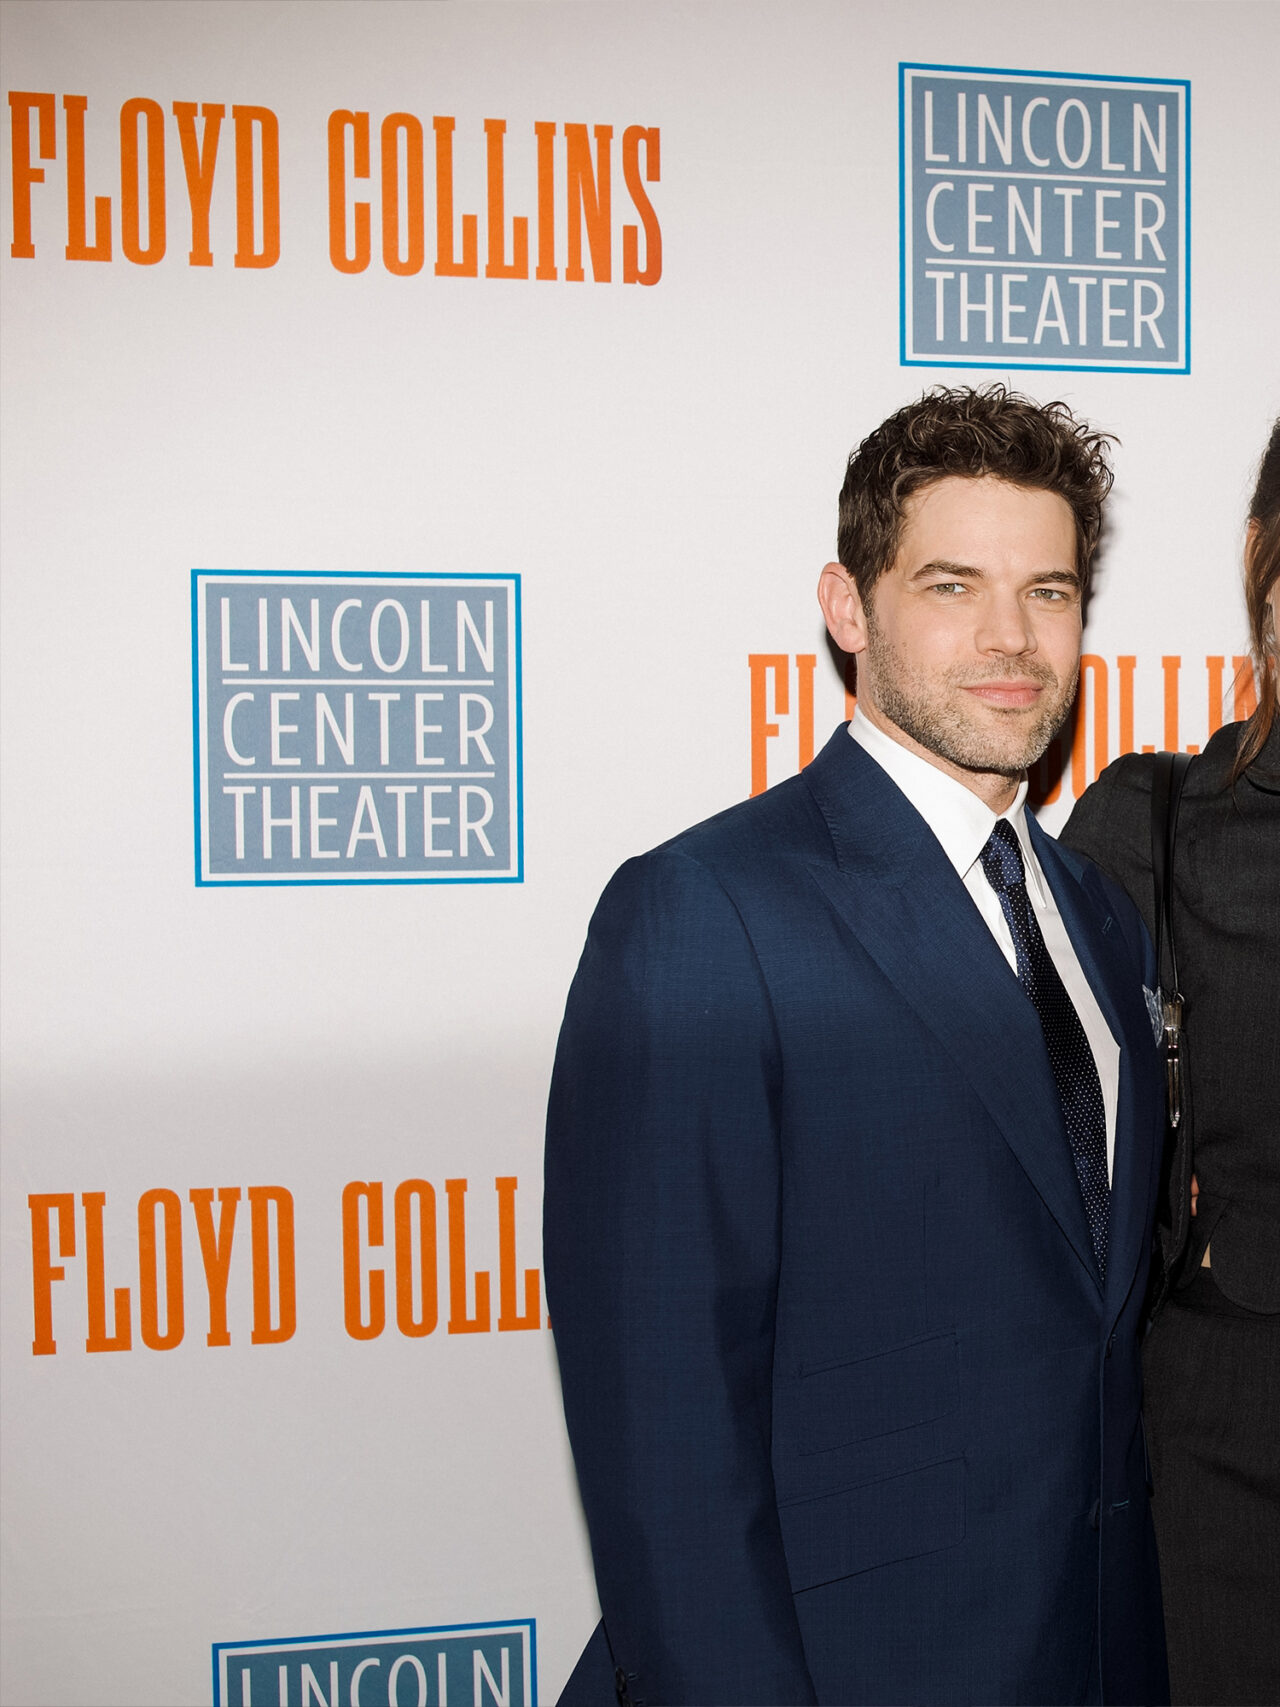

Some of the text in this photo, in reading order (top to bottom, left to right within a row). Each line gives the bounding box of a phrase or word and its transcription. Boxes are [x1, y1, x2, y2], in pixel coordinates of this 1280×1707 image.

[924, 90, 1167, 173] LINCOLN
[8, 91, 662, 286] FLOYD COLLINS
[925, 181, 1167, 262] CENTER
[924, 270, 1166, 349] THEATER
[220, 597, 494, 673] LINCOLN
[222, 692, 495, 766] CENTER
[1029, 654, 1274, 805] OLLI
[222, 785, 495, 860] THEATER
[28, 1176, 552, 1355] FLOYD COLL
